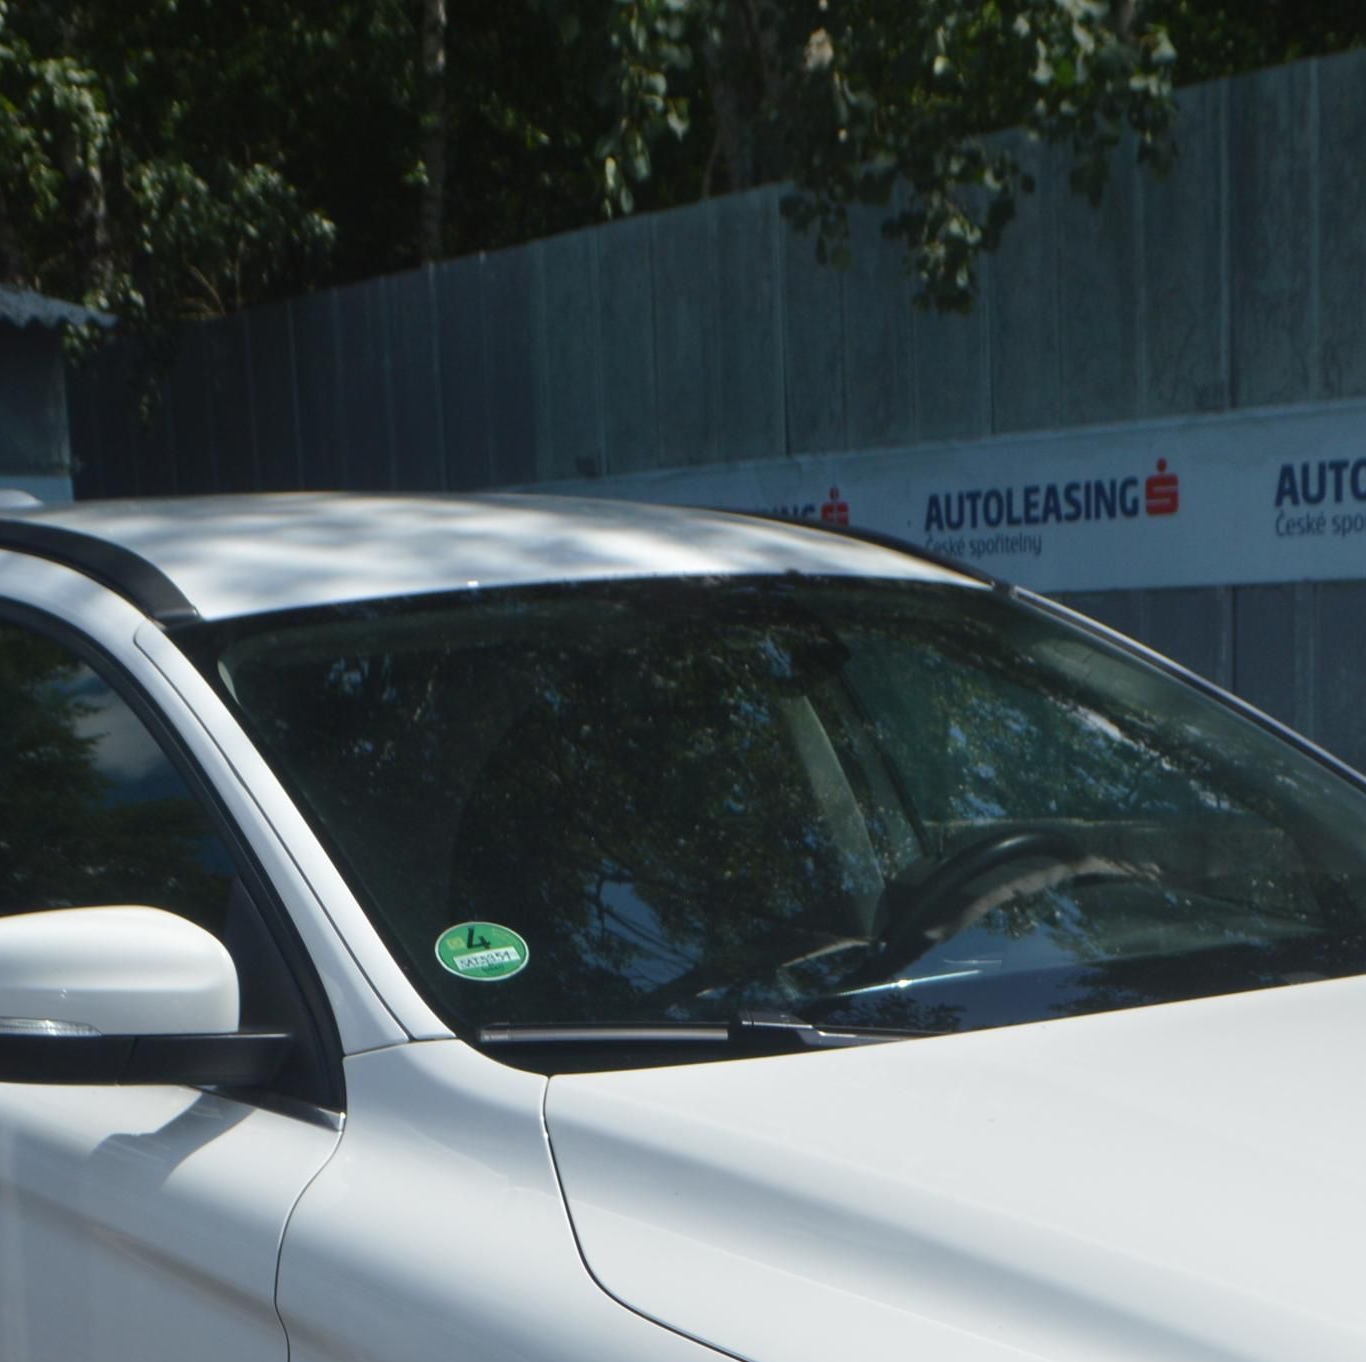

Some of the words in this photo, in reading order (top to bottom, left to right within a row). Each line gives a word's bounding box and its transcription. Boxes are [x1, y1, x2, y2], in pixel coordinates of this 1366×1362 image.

[925, 477, 1140, 533] AUTOLEASING
[1275, 508, 1326, 537] České
[969, 531, 1042, 559] spořitelny
[466, 926, 492, 950] 4
